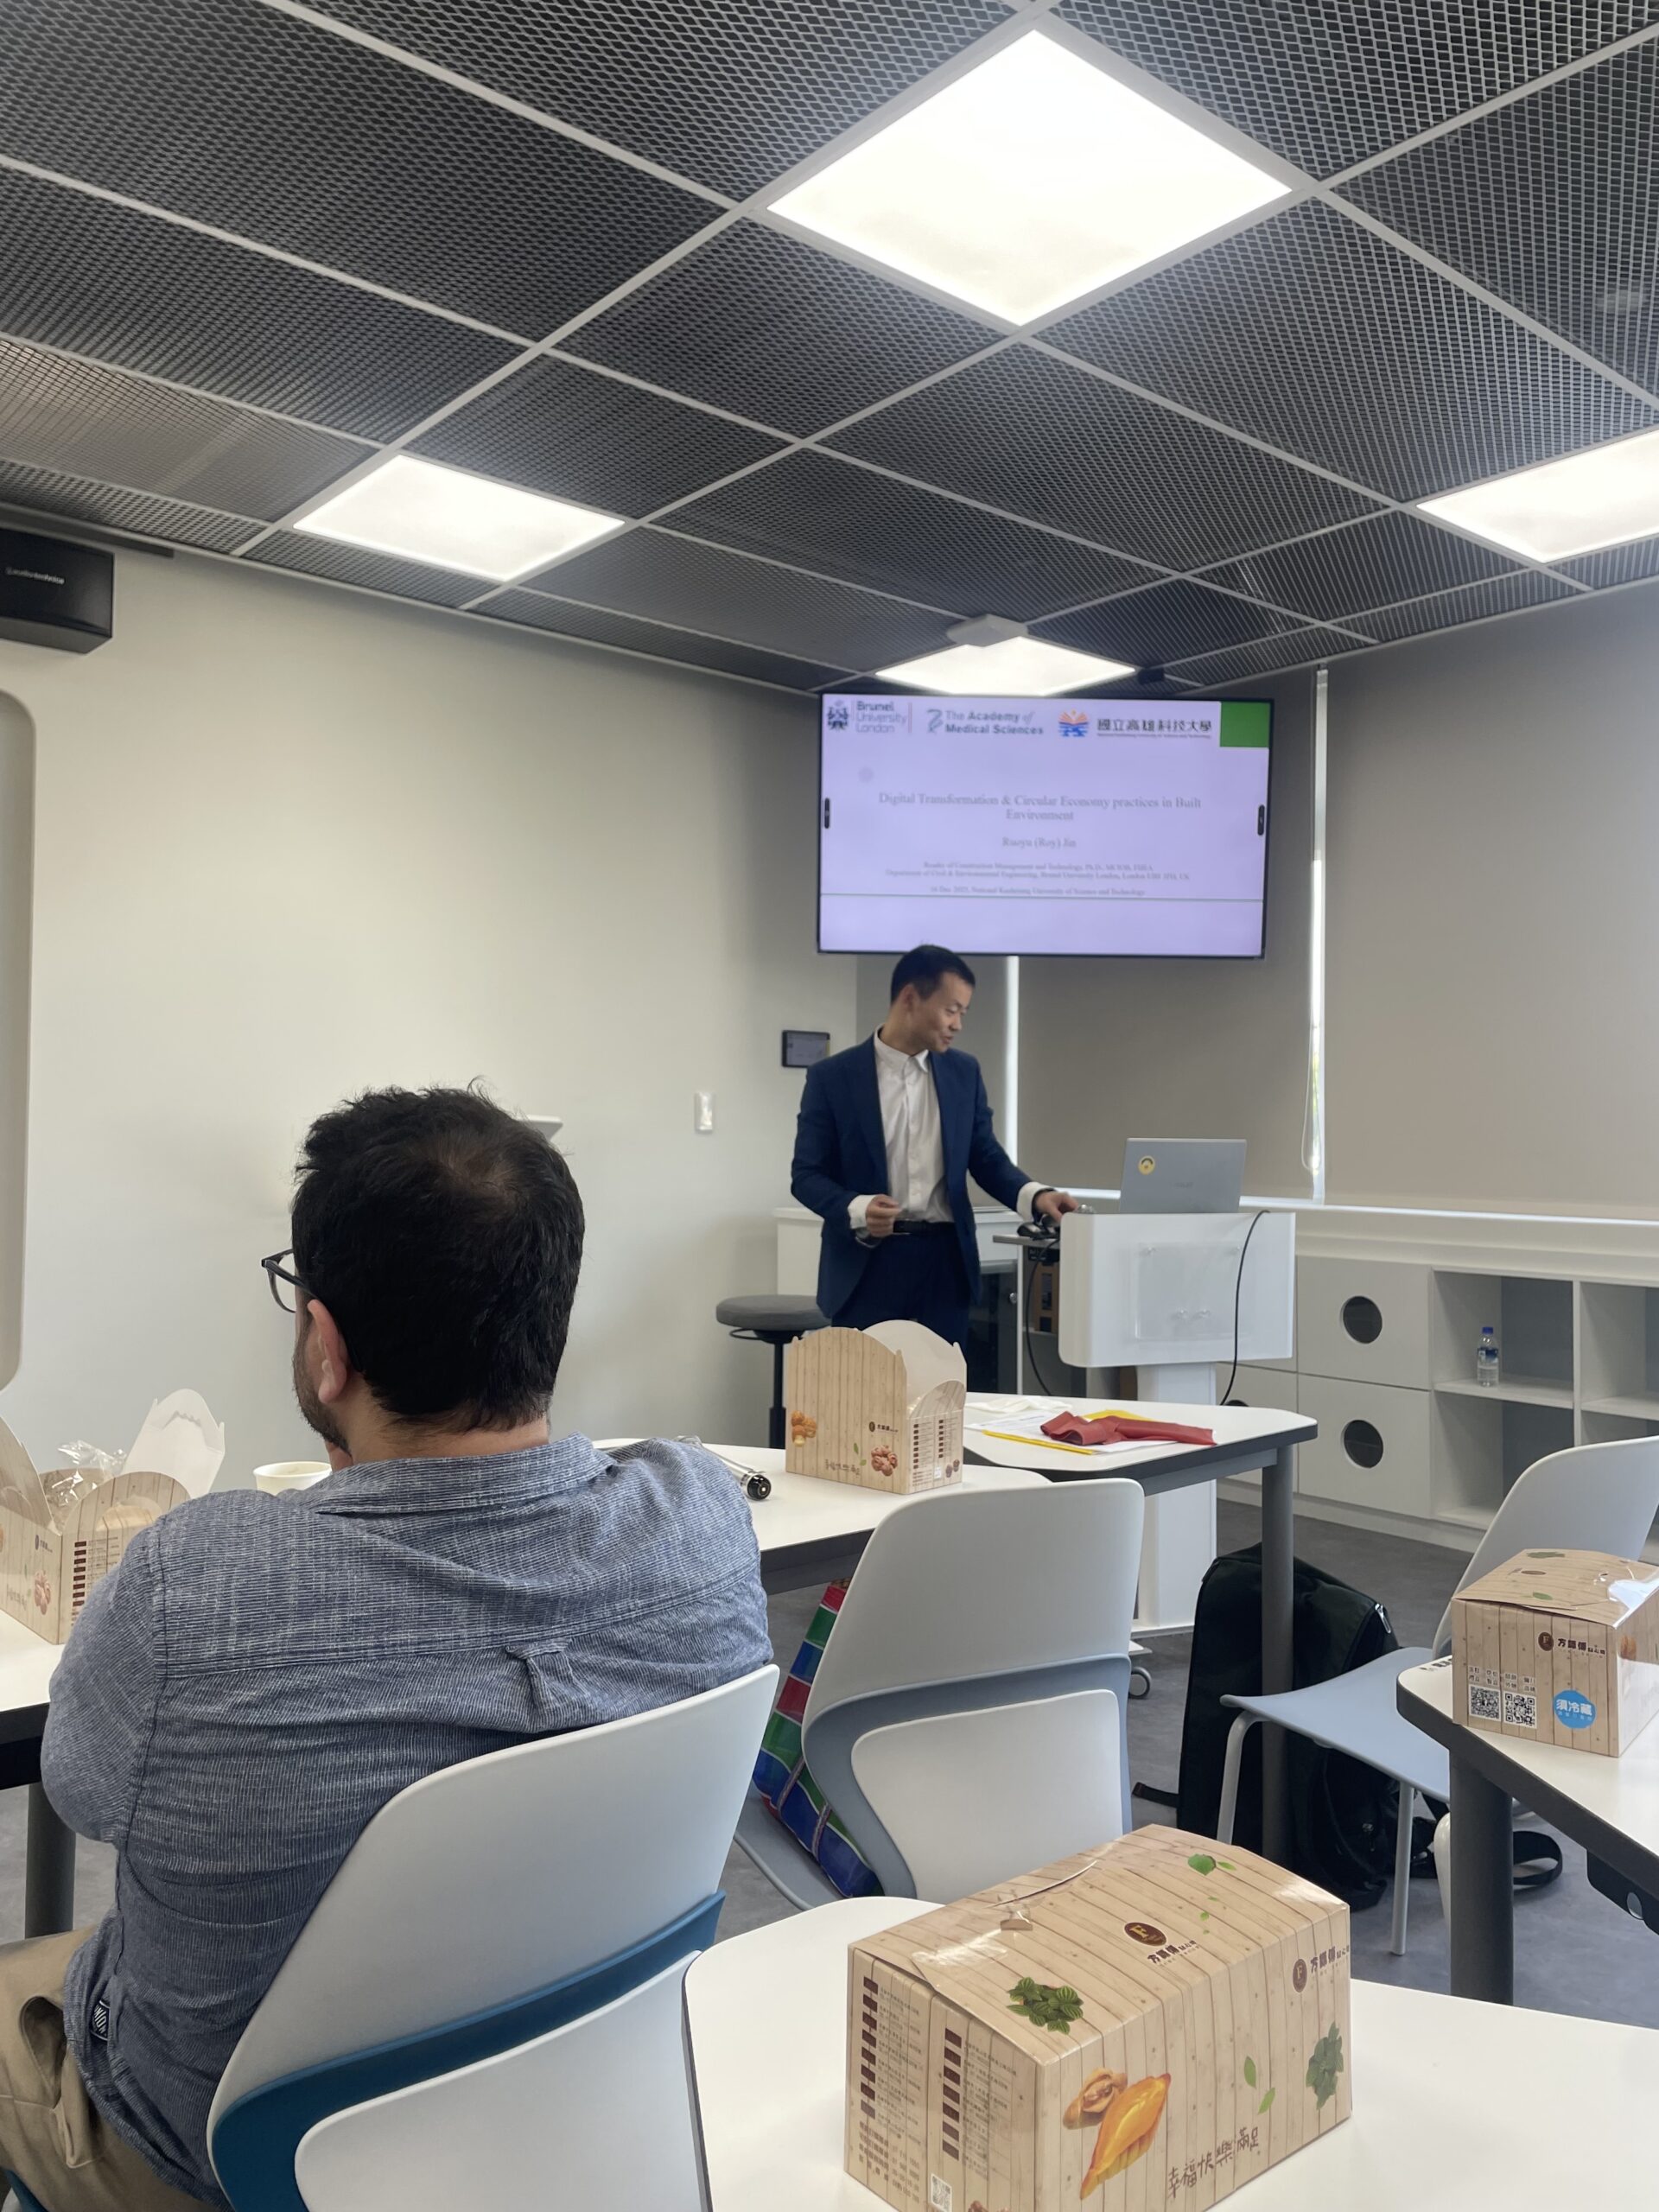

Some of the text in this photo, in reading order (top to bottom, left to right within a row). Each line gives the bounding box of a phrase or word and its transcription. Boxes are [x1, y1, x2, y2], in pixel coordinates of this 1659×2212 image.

[857, 701, 894, 711] Brunel
[856, 712, 907, 724] University
[946, 710, 1036, 723] The Academy of
[856, 723, 895, 734] London
[945, 724, 1044, 735] Medical Sciences
[879, 793, 1201, 810] Digital Transformation & Circular Economy practices in Built
[1006, 809, 1074, 821] Environment
[1556, 1699, 1592, 1716] 須冷藏
